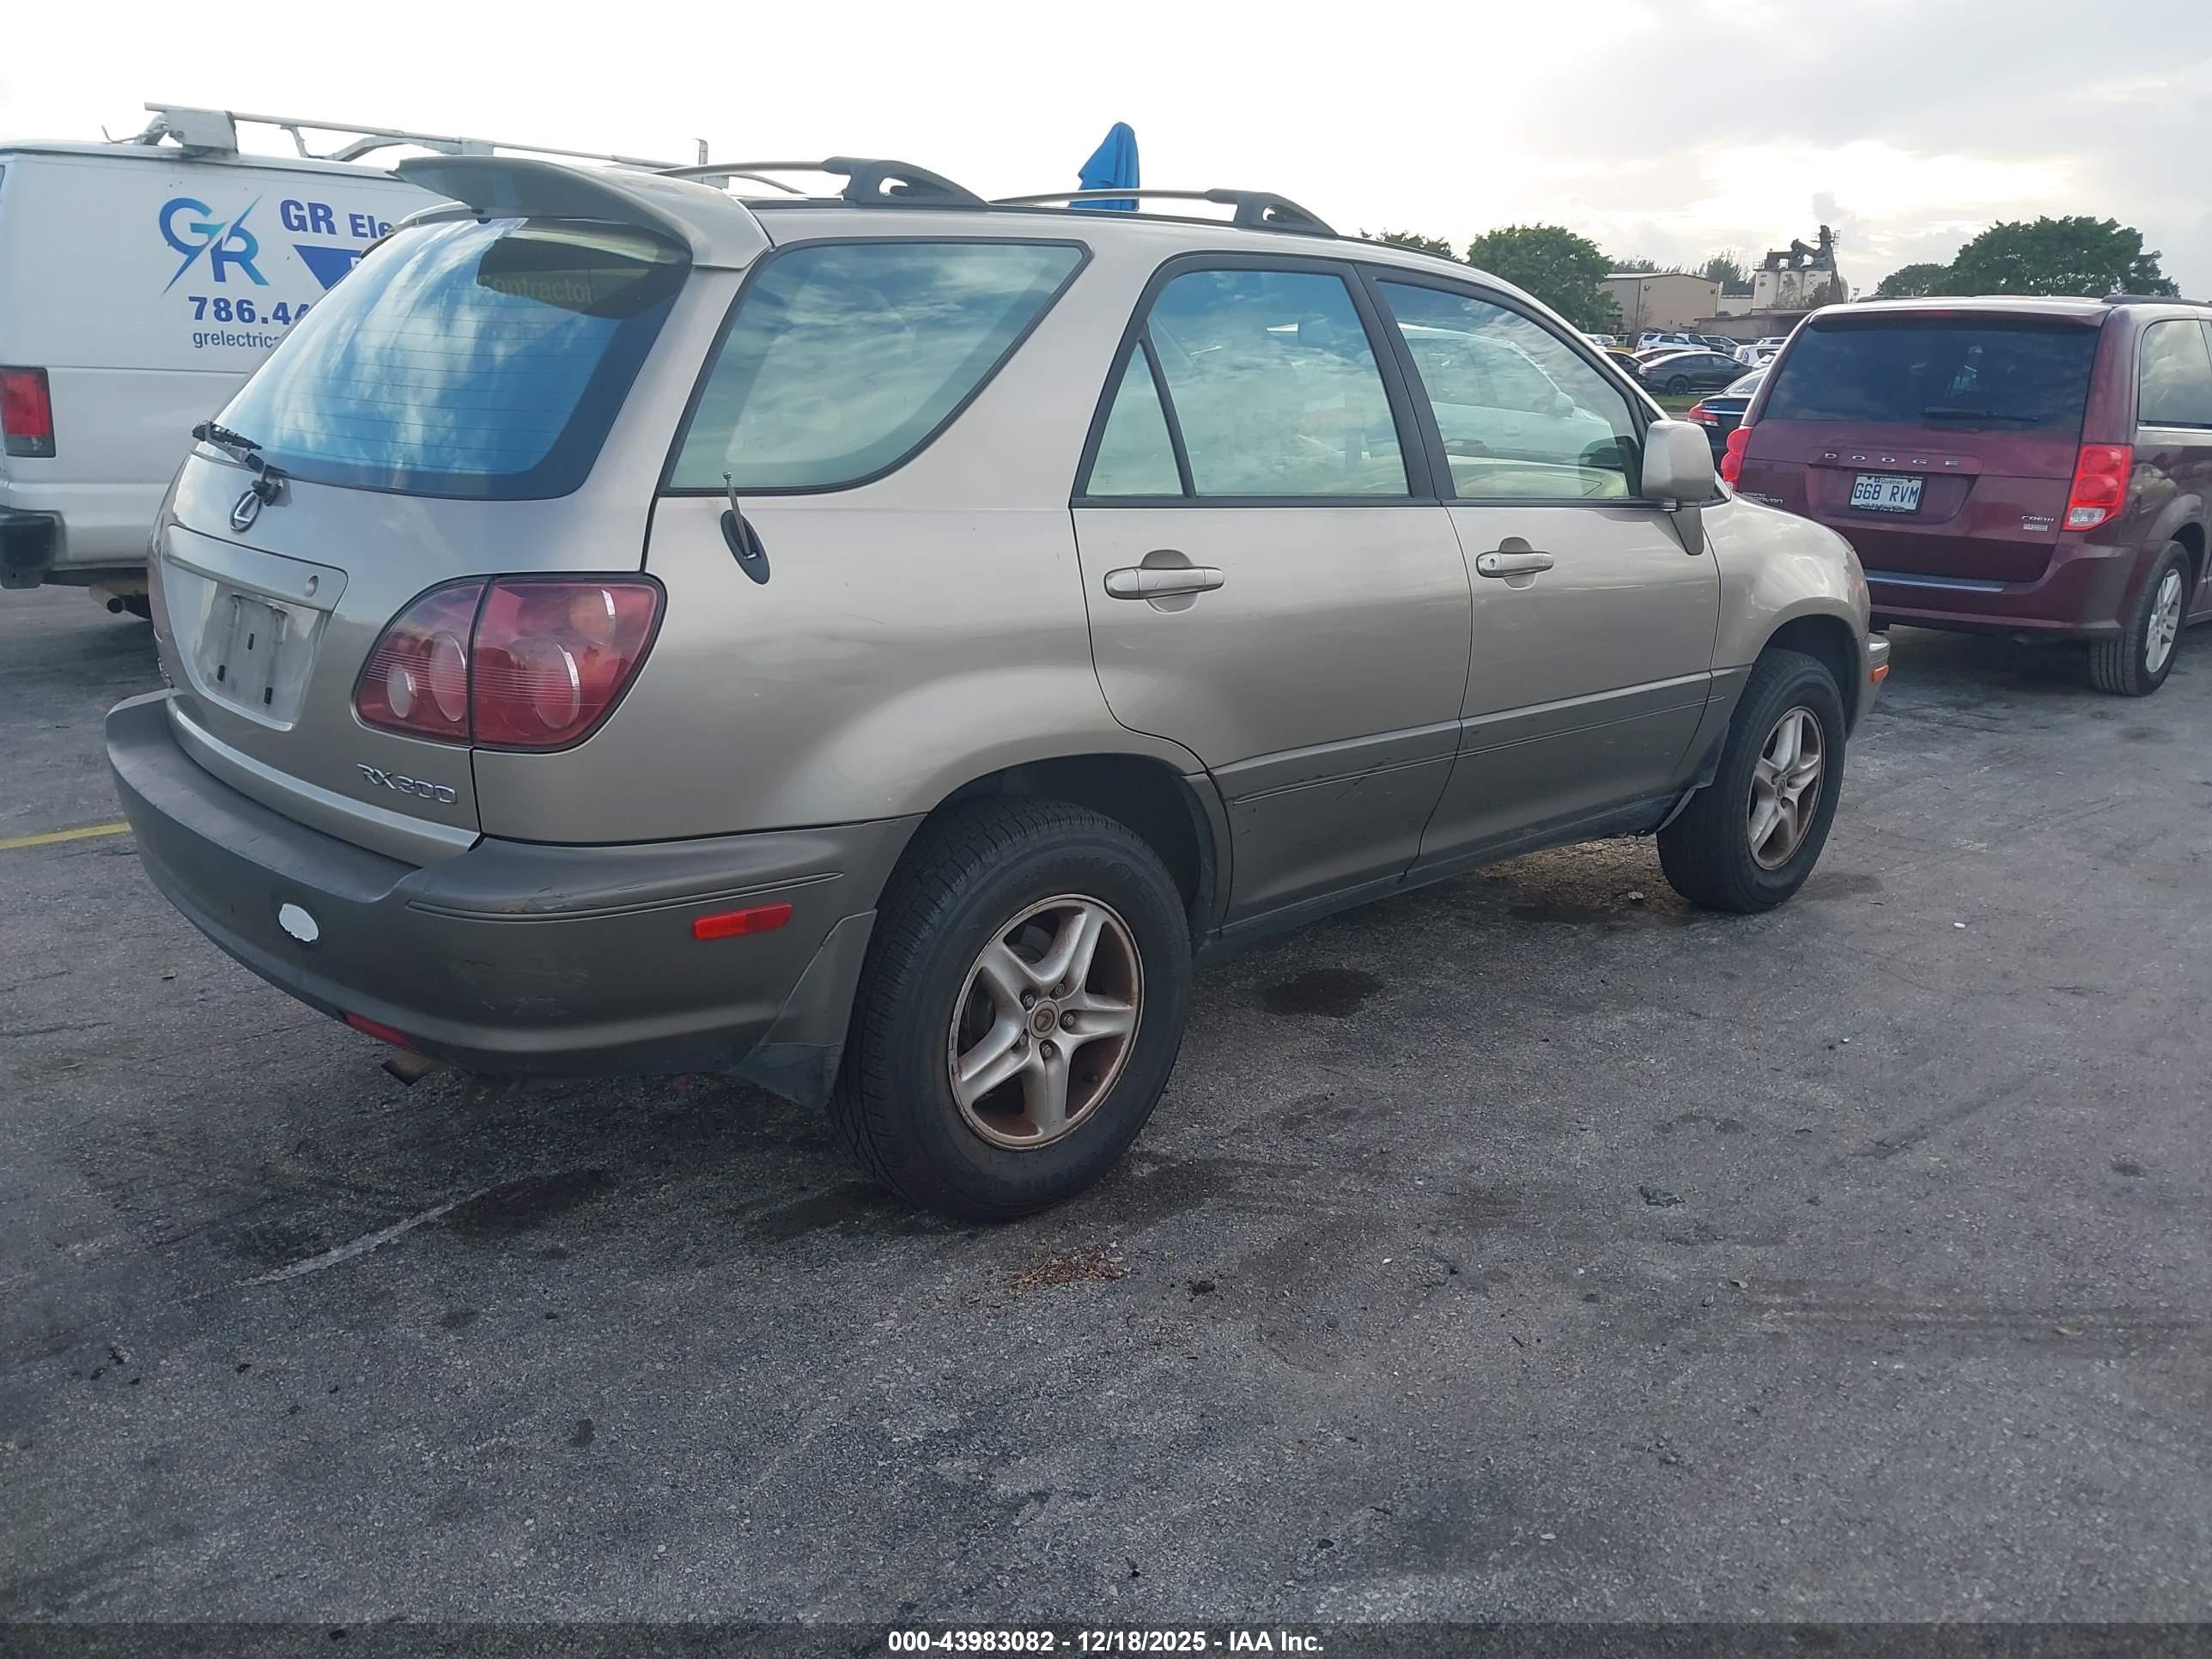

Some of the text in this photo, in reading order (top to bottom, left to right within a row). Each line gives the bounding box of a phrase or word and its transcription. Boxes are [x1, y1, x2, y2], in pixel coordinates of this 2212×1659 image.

[279, 198, 337, 236] GR
[191, 330, 281, 349] grelectric
[1824, 452, 1960, 467] DODGE
[1854, 483, 1919, 504] G68 RVM
